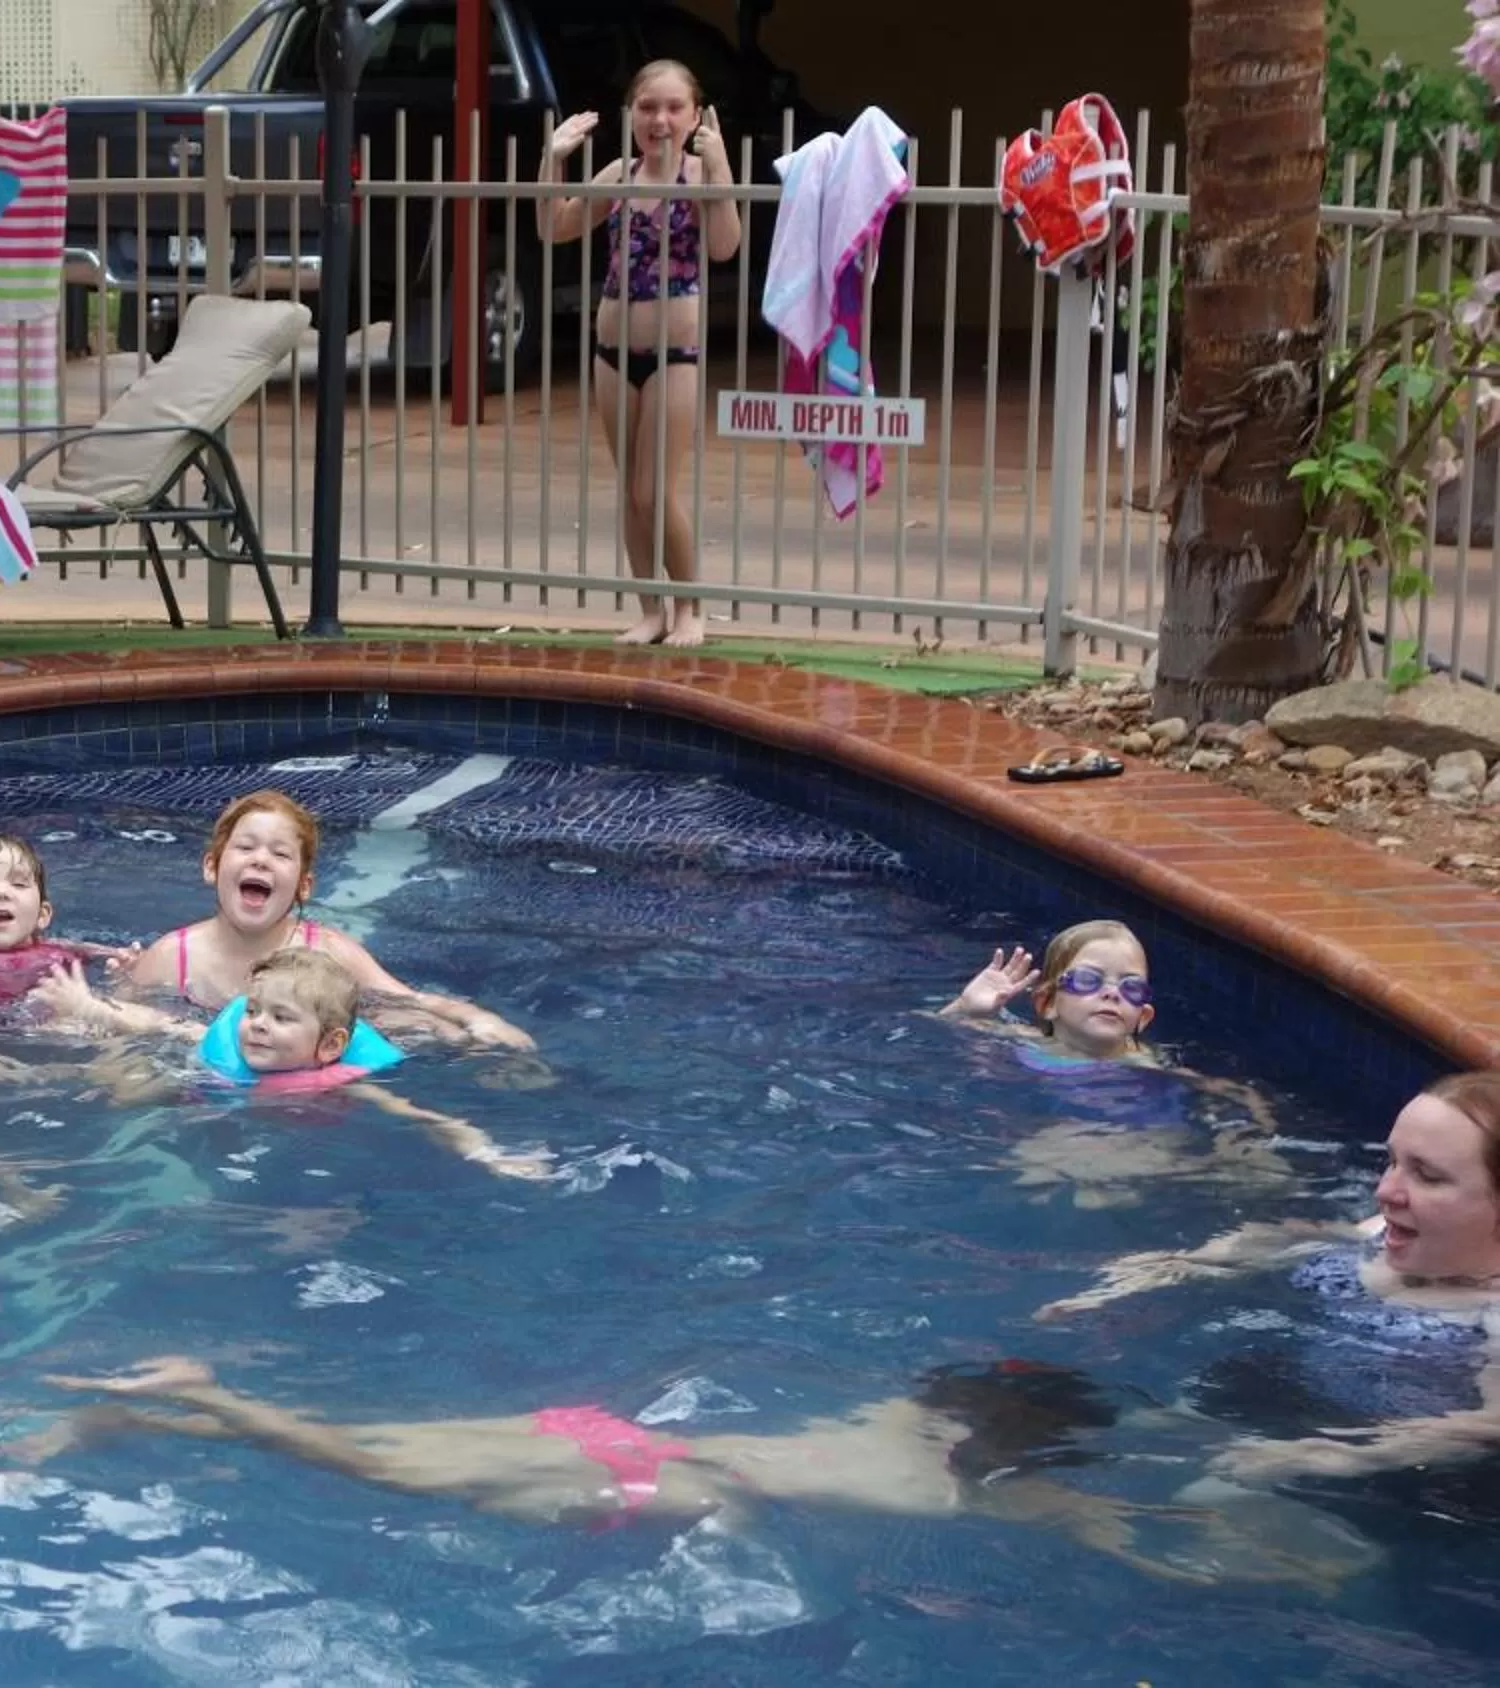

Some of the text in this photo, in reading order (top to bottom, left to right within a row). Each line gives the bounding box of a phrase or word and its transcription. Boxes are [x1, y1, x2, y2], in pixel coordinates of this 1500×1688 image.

[731, 397, 909, 438] MIN. DEPTH 1m
